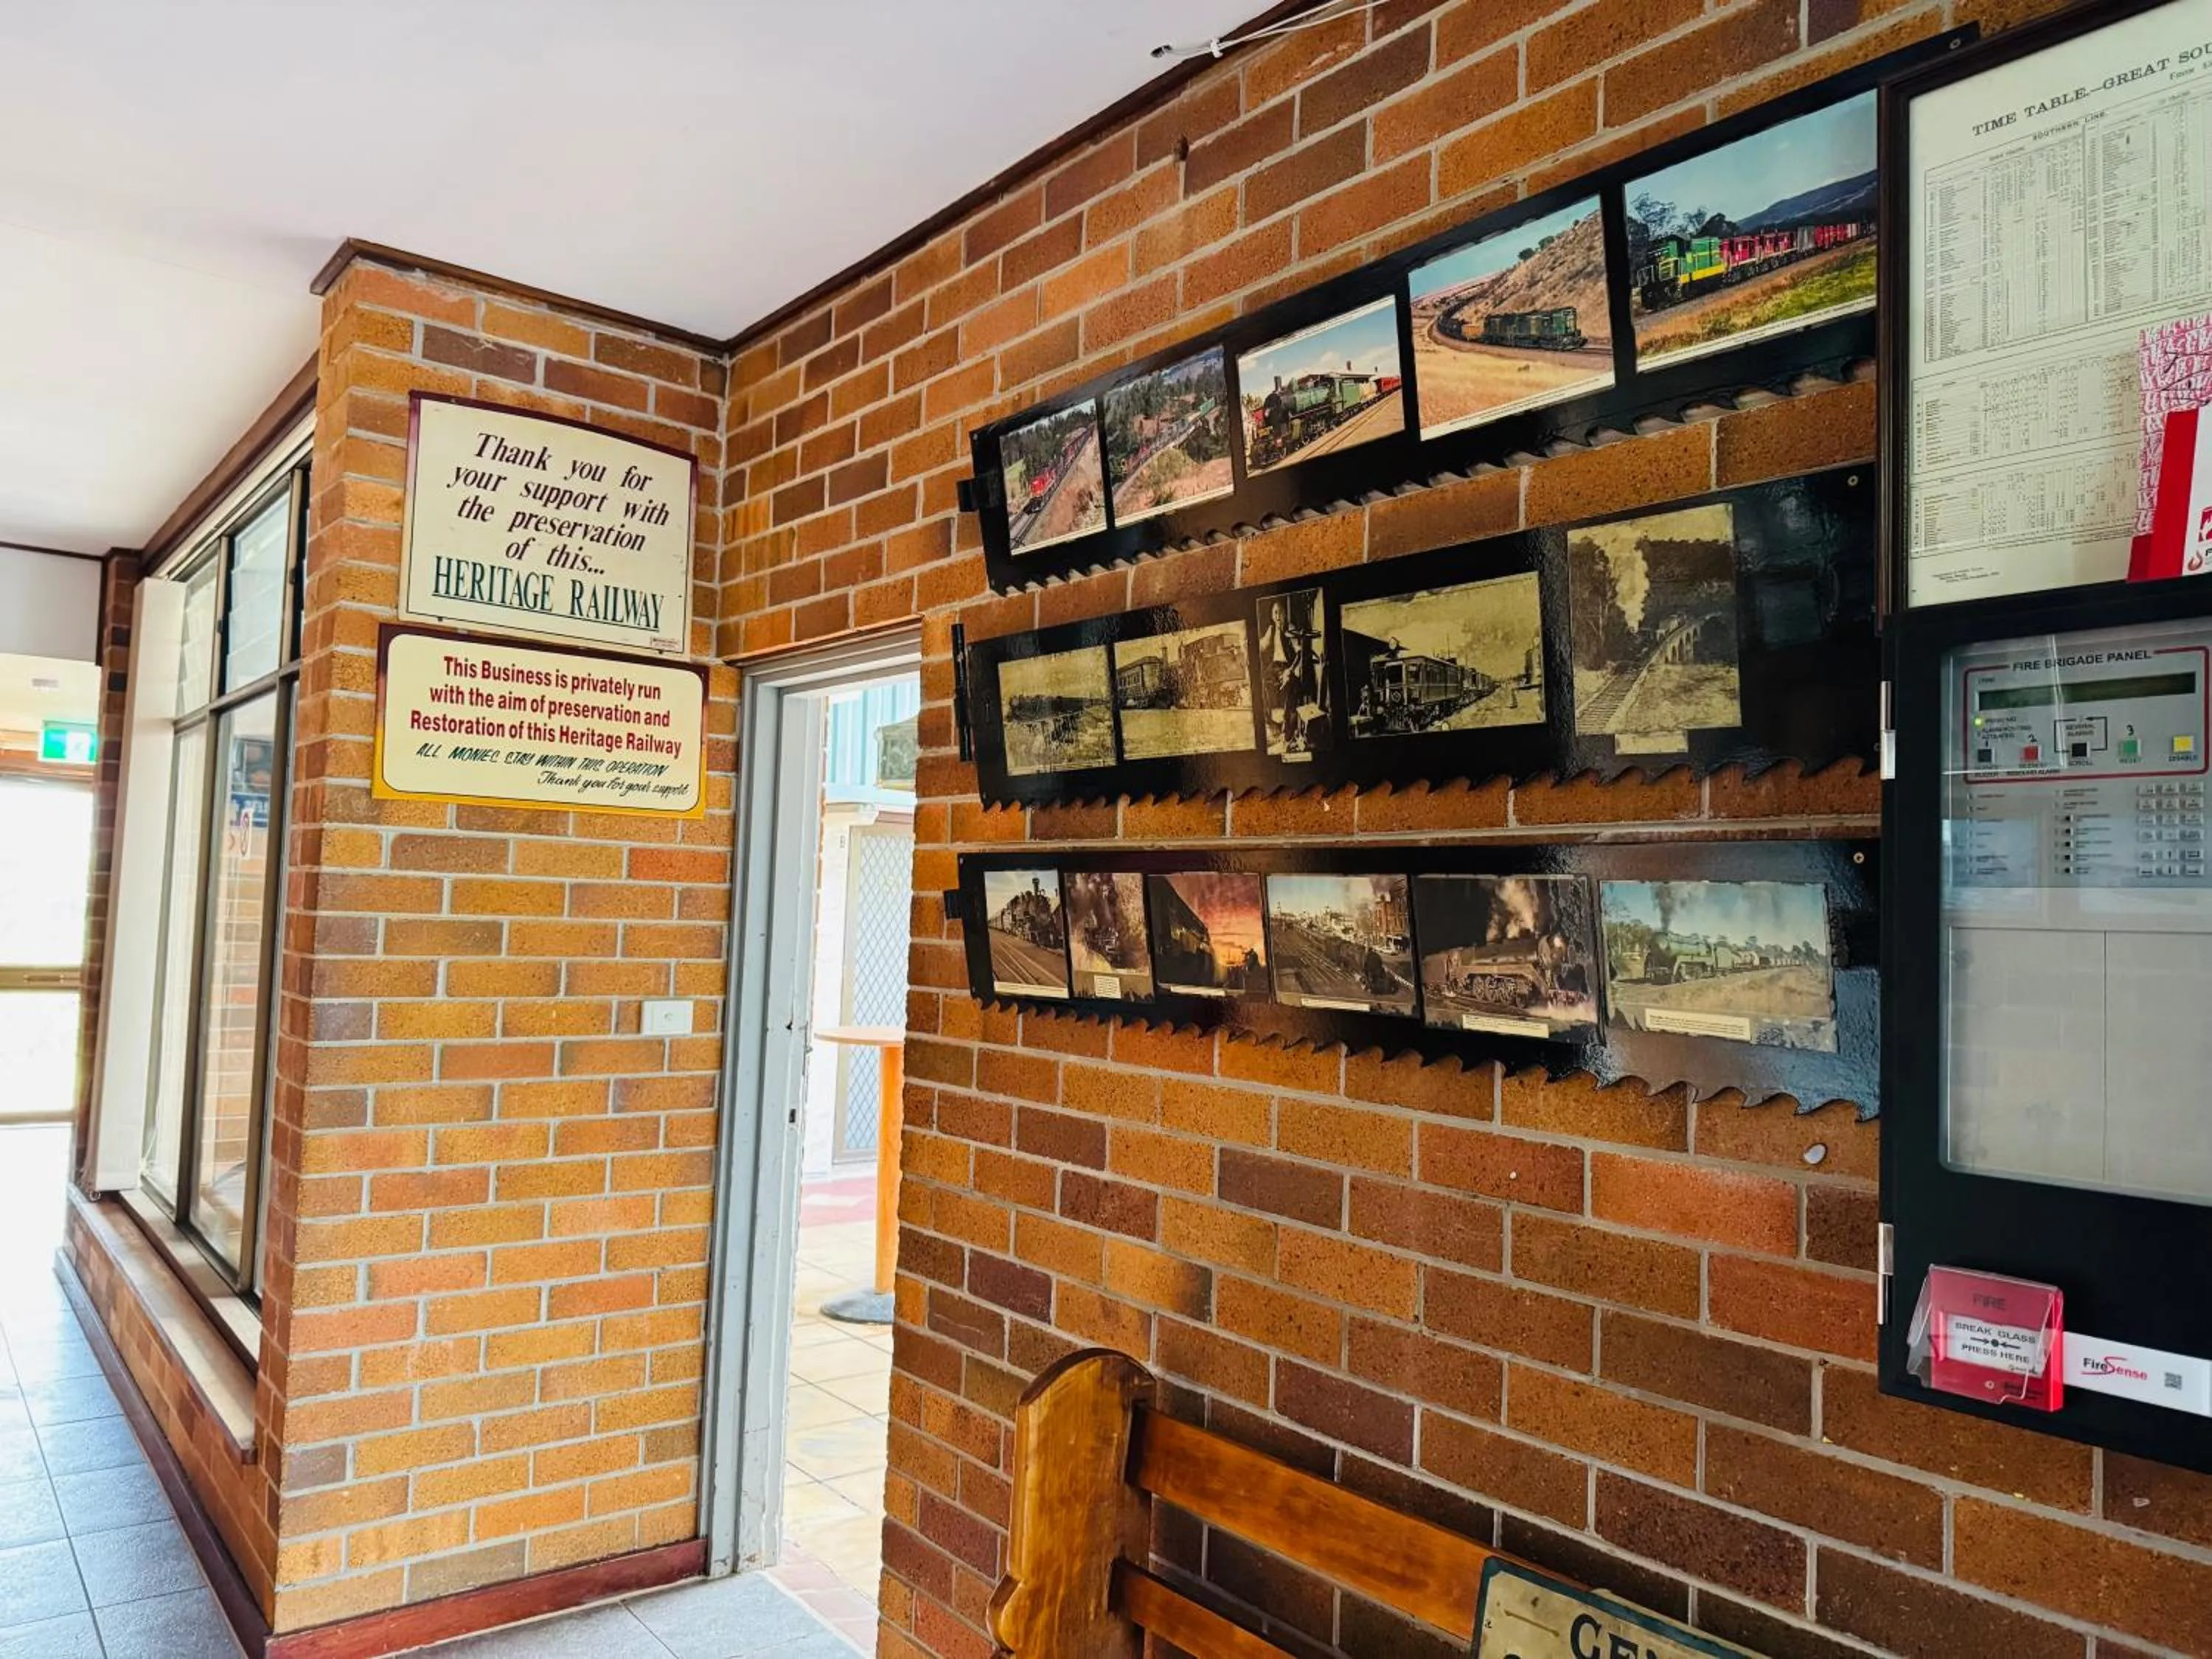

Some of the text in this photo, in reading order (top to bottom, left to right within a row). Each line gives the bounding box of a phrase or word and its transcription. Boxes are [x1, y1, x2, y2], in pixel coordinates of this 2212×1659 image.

[1972, 111, 2017, 136] TIME
[474, 432, 653, 492] Thank you for
[447, 466, 670, 526] your support with
[457, 495, 647, 552] the preservation
[505, 538, 606, 575] of this...
[432, 554, 664, 630] HERITAGE RAILWAY
[443, 655, 661, 700] This Business is privately run
[2012, 650, 2152, 672] FIRE BRIGADE PANEL
[429, 684, 670, 728] with the aim of preservation and
[410, 710, 683, 759] Restoration of this Heritage Railway
[2126, 724, 2135, 736] 3
[415, 742, 442, 758] ALL
[535, 753, 577, 769] WITHIN
[577, 757, 604, 772] THIS
[605, 760, 669, 778] OPERATION
[538, 771, 689, 800] Thank you for your support
[1972, 1293, 2006, 1311] FIRE
[1955, 1321, 2037, 1344] BREAK GLASS
[1961, 1343, 2030, 1363] PRESS HERE
[2081, 1356, 2148, 1381] FireSense
